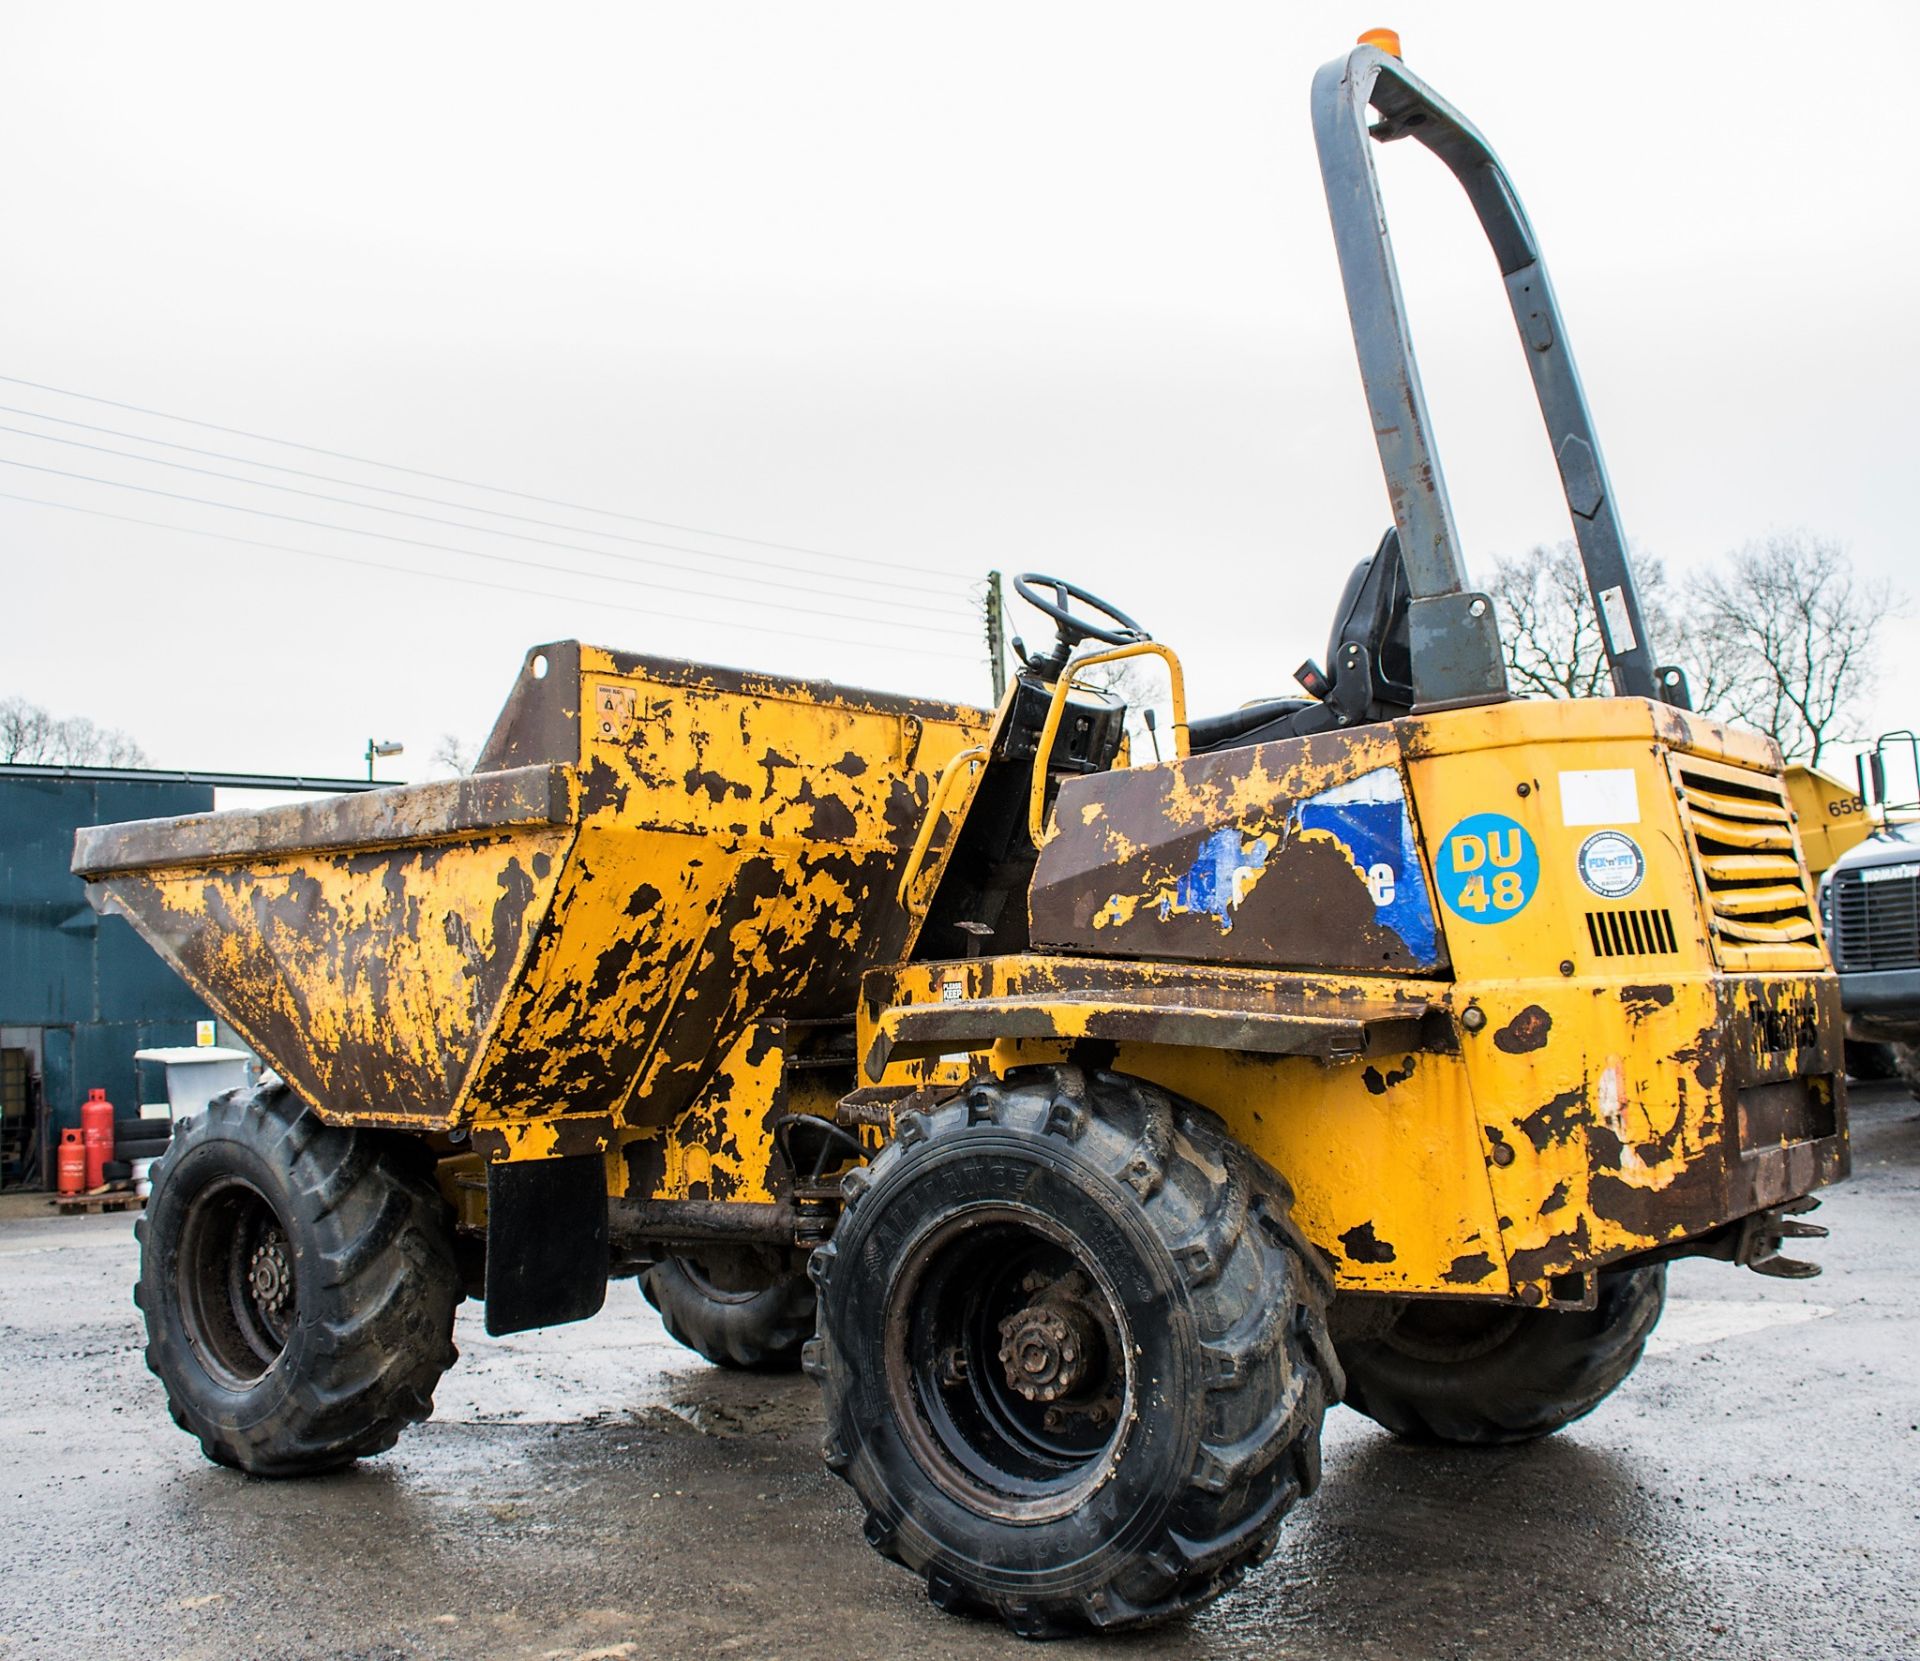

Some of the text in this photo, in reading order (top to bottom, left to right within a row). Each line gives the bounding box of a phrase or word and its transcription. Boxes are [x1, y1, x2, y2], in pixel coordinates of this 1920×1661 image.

[1828, 797, 1864, 818] 658
[1451, 828, 1522, 873] DU
[1458, 872, 1524, 912] 48
